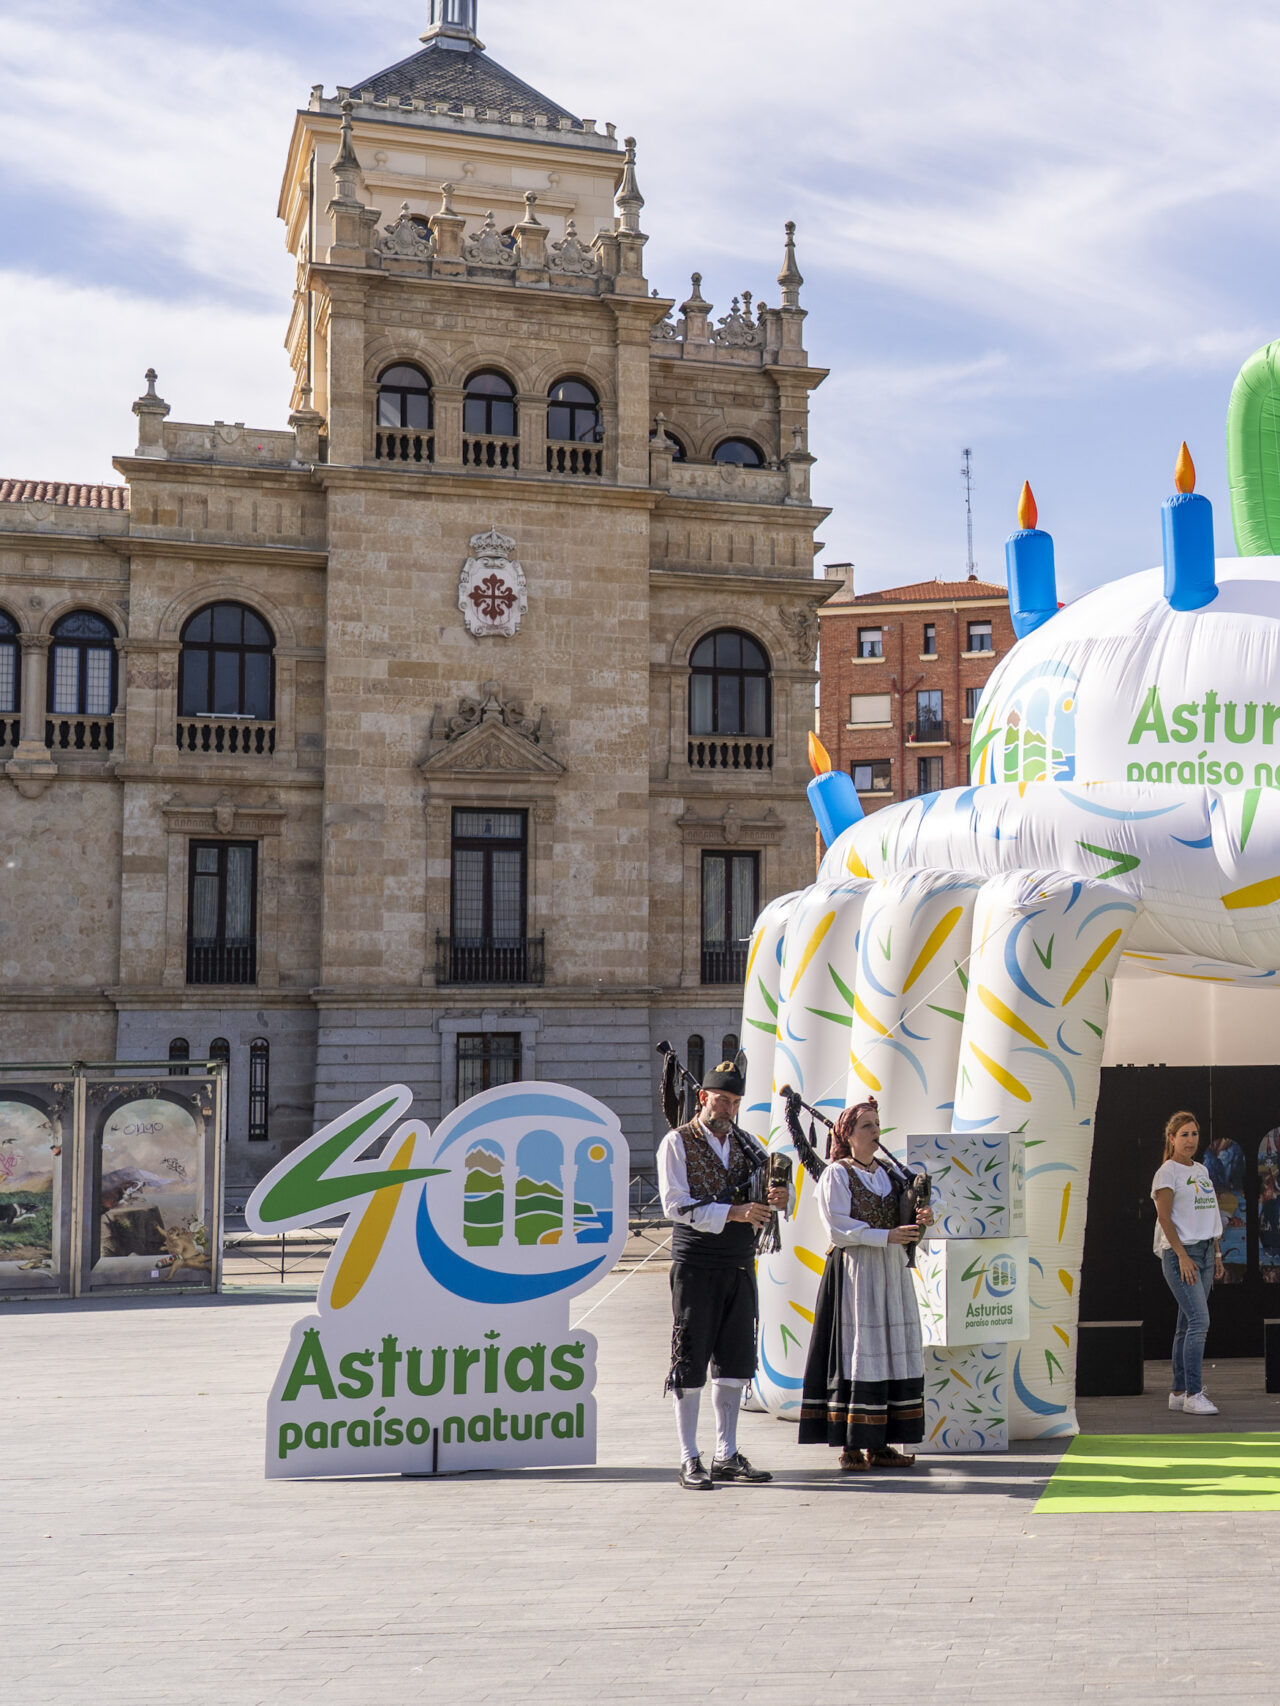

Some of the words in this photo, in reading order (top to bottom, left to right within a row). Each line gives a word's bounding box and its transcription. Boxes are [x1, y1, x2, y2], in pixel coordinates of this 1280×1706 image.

[966, 1302, 1013, 1318] Asturias
[990, 1316, 1013, 1326] natural
[281, 1327, 586, 1401] Asturias
[278, 1406, 431, 1459] paraíso
[442, 1402, 585, 1444] natural
